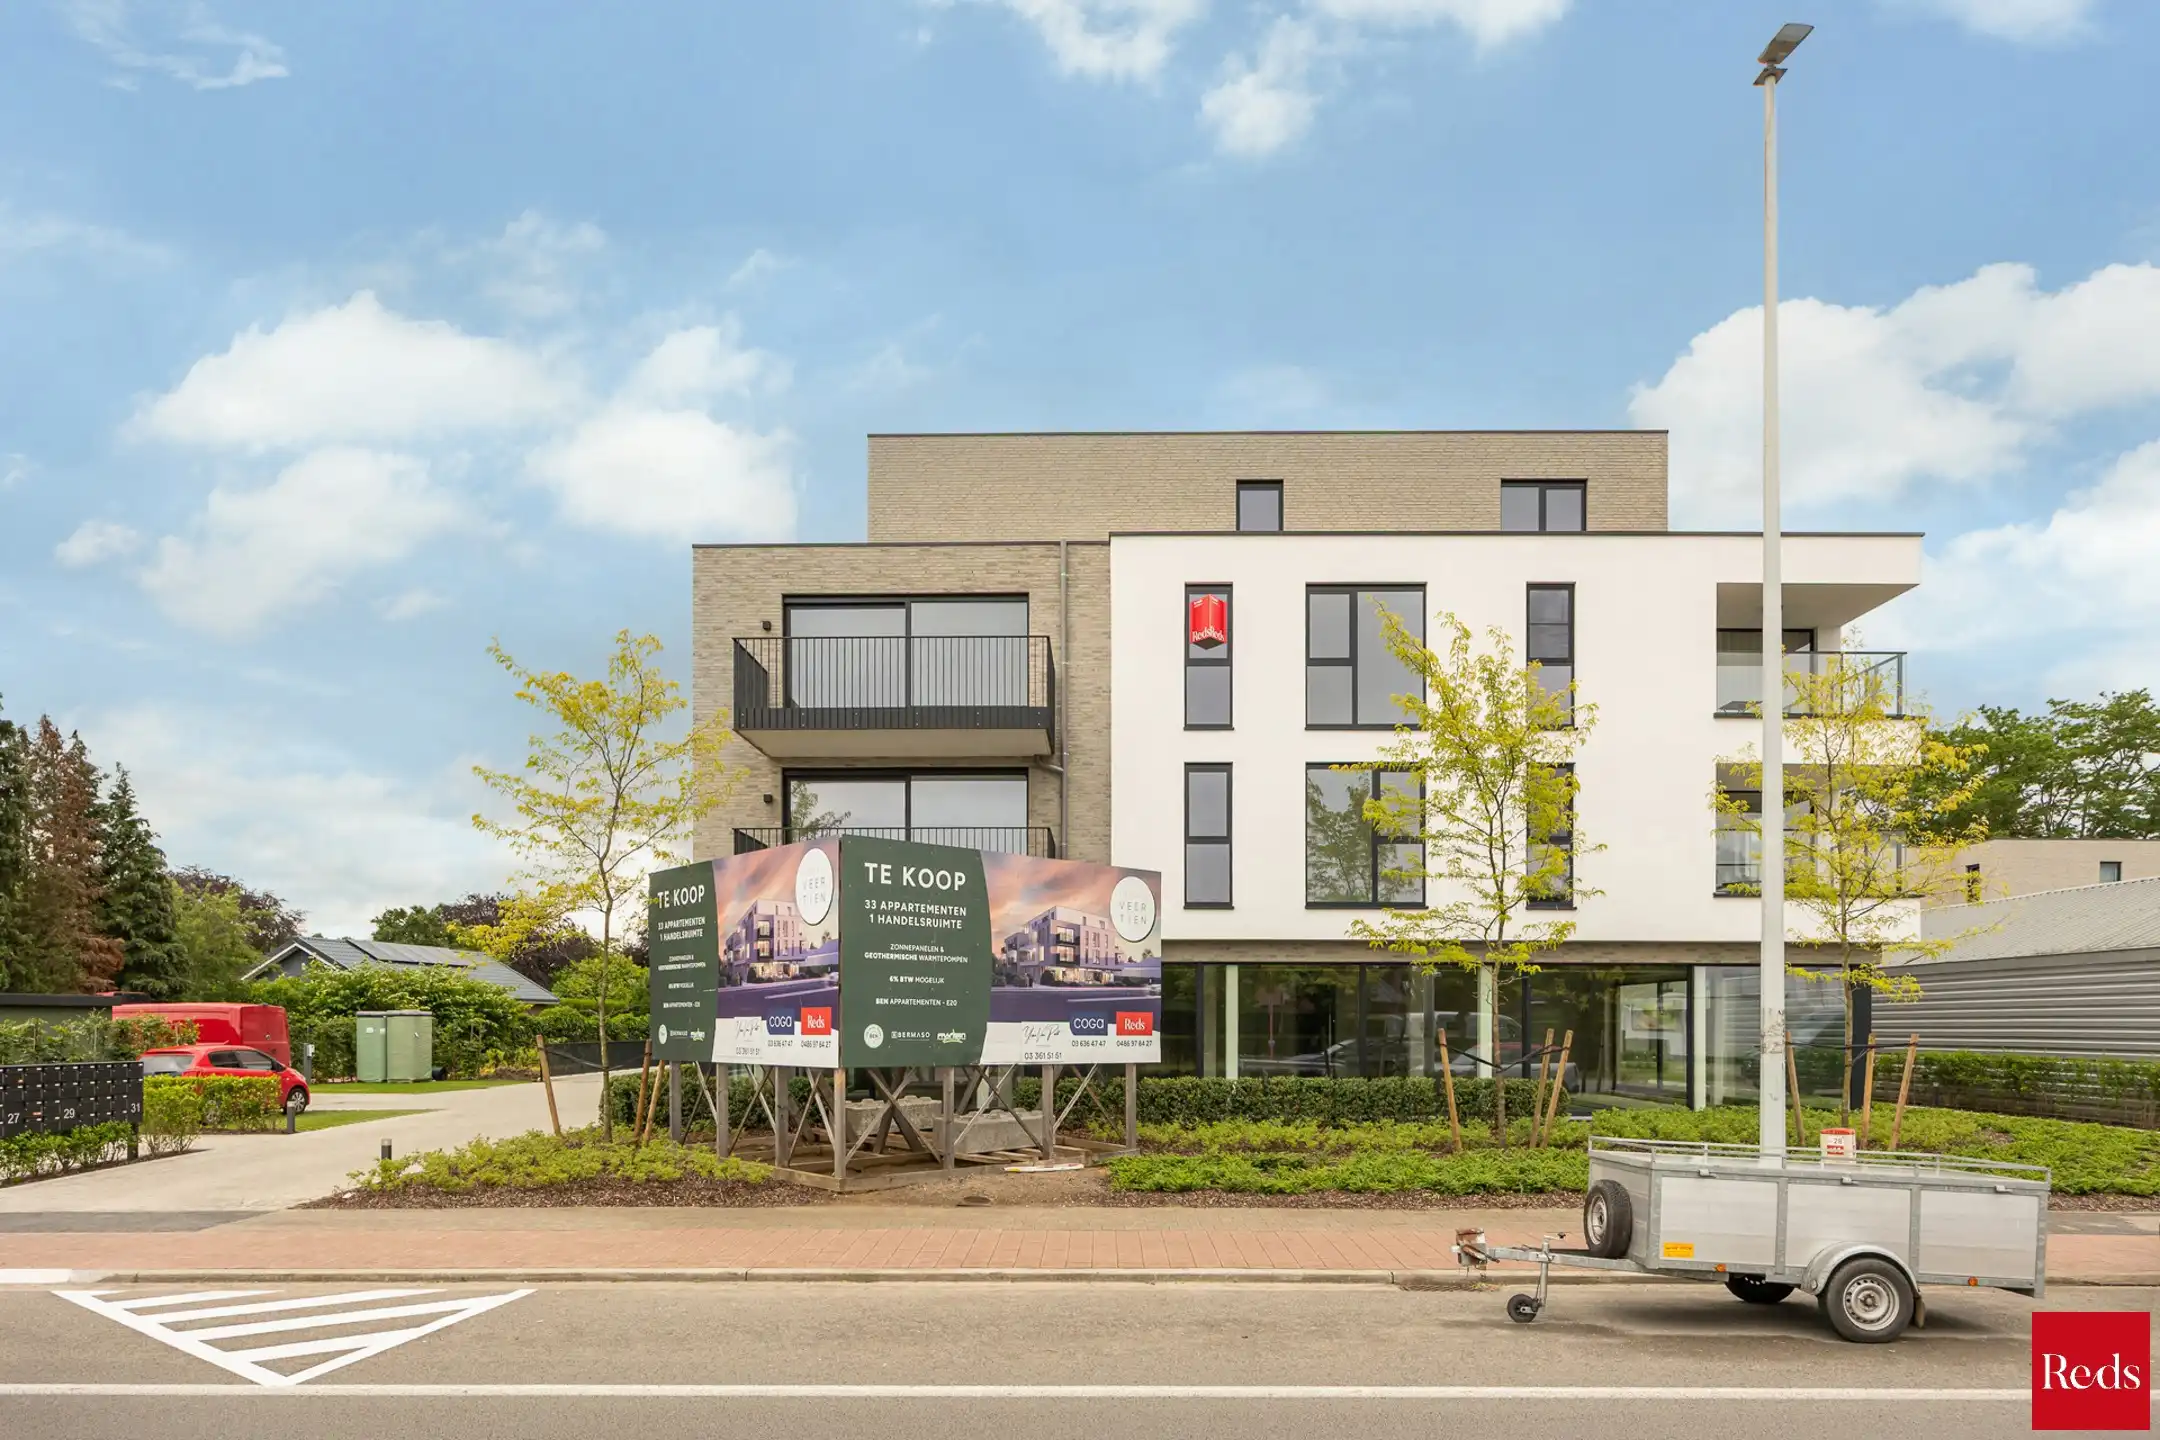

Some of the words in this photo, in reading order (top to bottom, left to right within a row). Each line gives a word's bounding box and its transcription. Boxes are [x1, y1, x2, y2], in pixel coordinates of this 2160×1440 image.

[864, 862, 892, 884] TE
[902, 866, 966, 890] KOOP
[657, 890, 670, 908] TE
[674, 884, 704, 906] KOOP
[864, 900, 876, 910] 33
[880, 901, 966, 916] APPARTEMENTEN
[1120, 901, 1146, 912] VEER
[869, 914, 874, 924] 1
[878, 914, 962, 929] HANDELSRUIMTE
[1120, 914, 1147, 924] TIEN
[890, 944, 939, 952] ZONNEPANELEN
[864, 952, 918, 961] GEOTHERMISCHE
[918, 955, 968, 963] WARMTEPOMPEN
[807, 1014, 825, 1028] Reds
[1124, 1018, 1146, 1030] Reds
[1025, 1052, 1033, 1060] 03
[7, 1113, 20, 1124] 27
[64, 1108, 75, 1119] 29
[130, 1103, 140, 1113] 31
